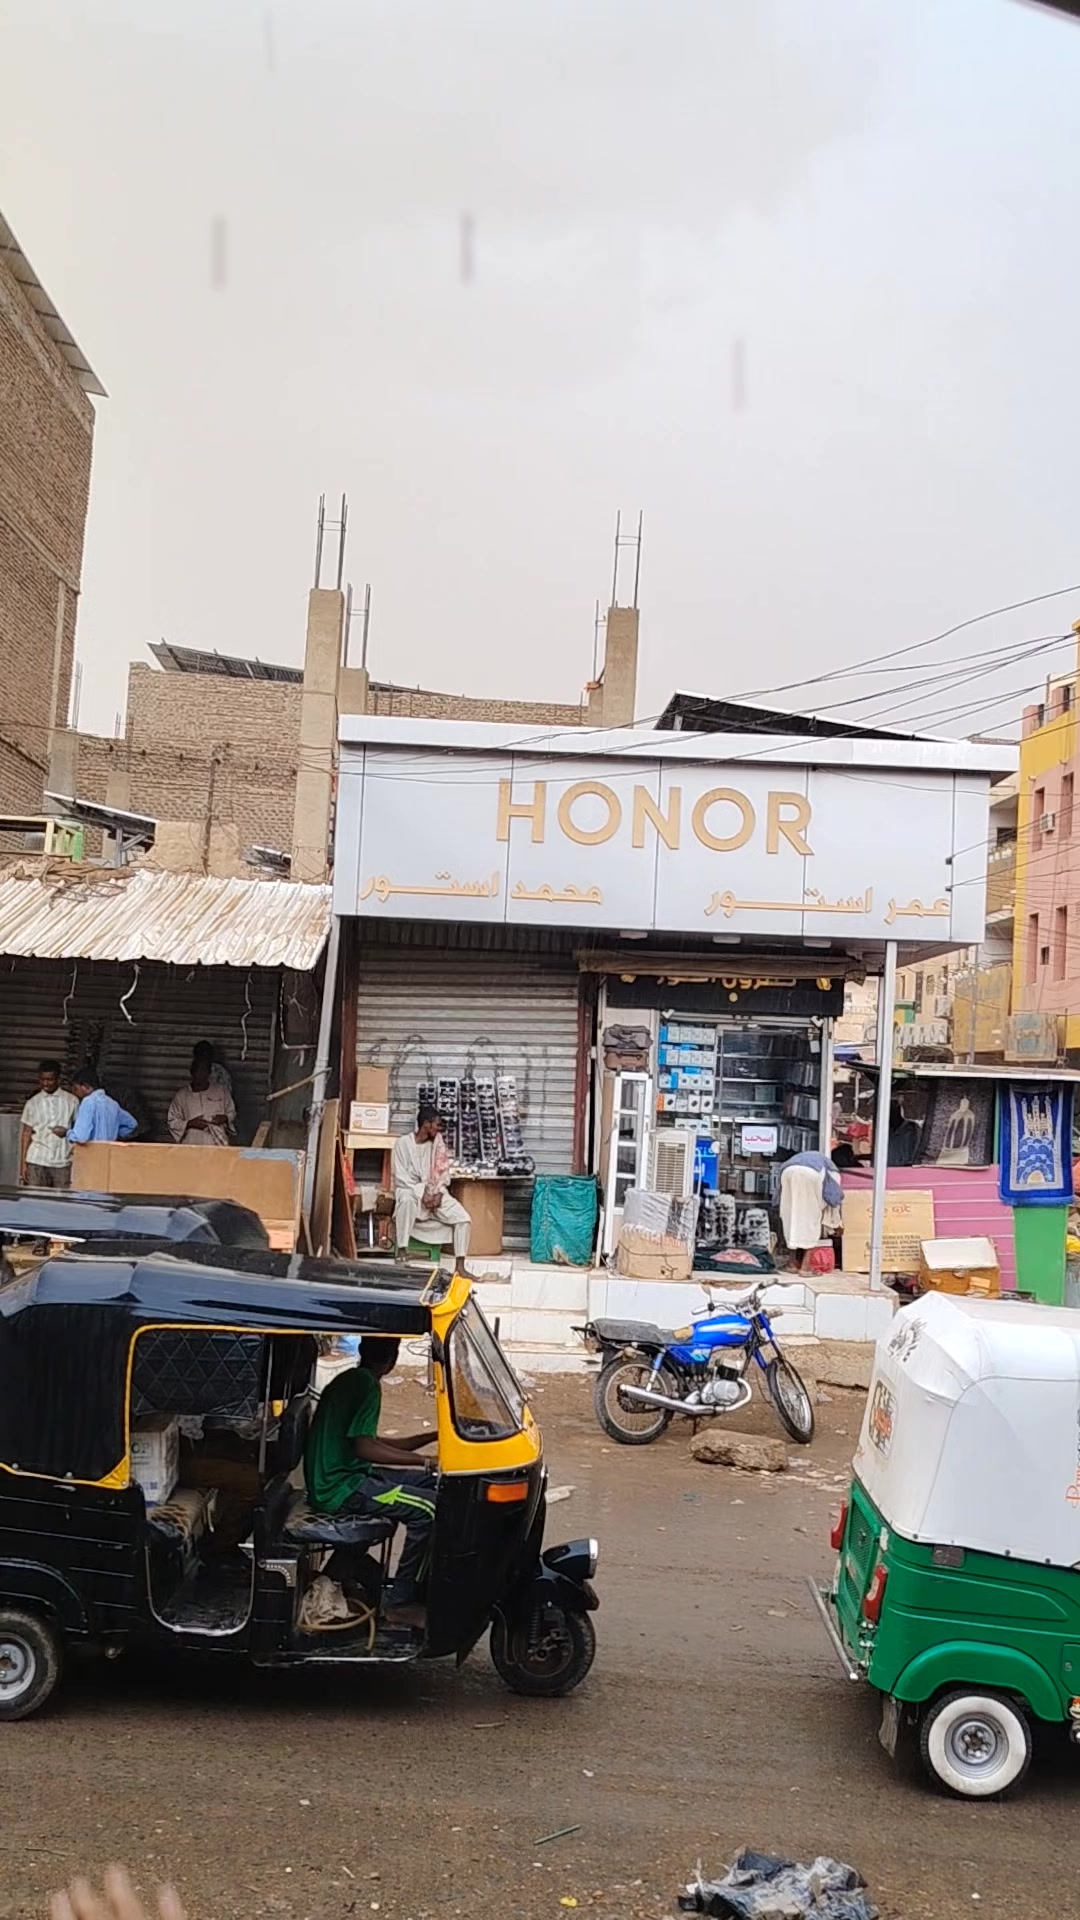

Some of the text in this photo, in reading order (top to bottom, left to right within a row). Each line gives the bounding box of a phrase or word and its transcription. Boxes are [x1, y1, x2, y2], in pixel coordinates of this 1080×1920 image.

[496, 777, 815, 856] HONOR
[358, 869, 603, 905] محمد استور
[704, 886, 950, 925] عمر استور
